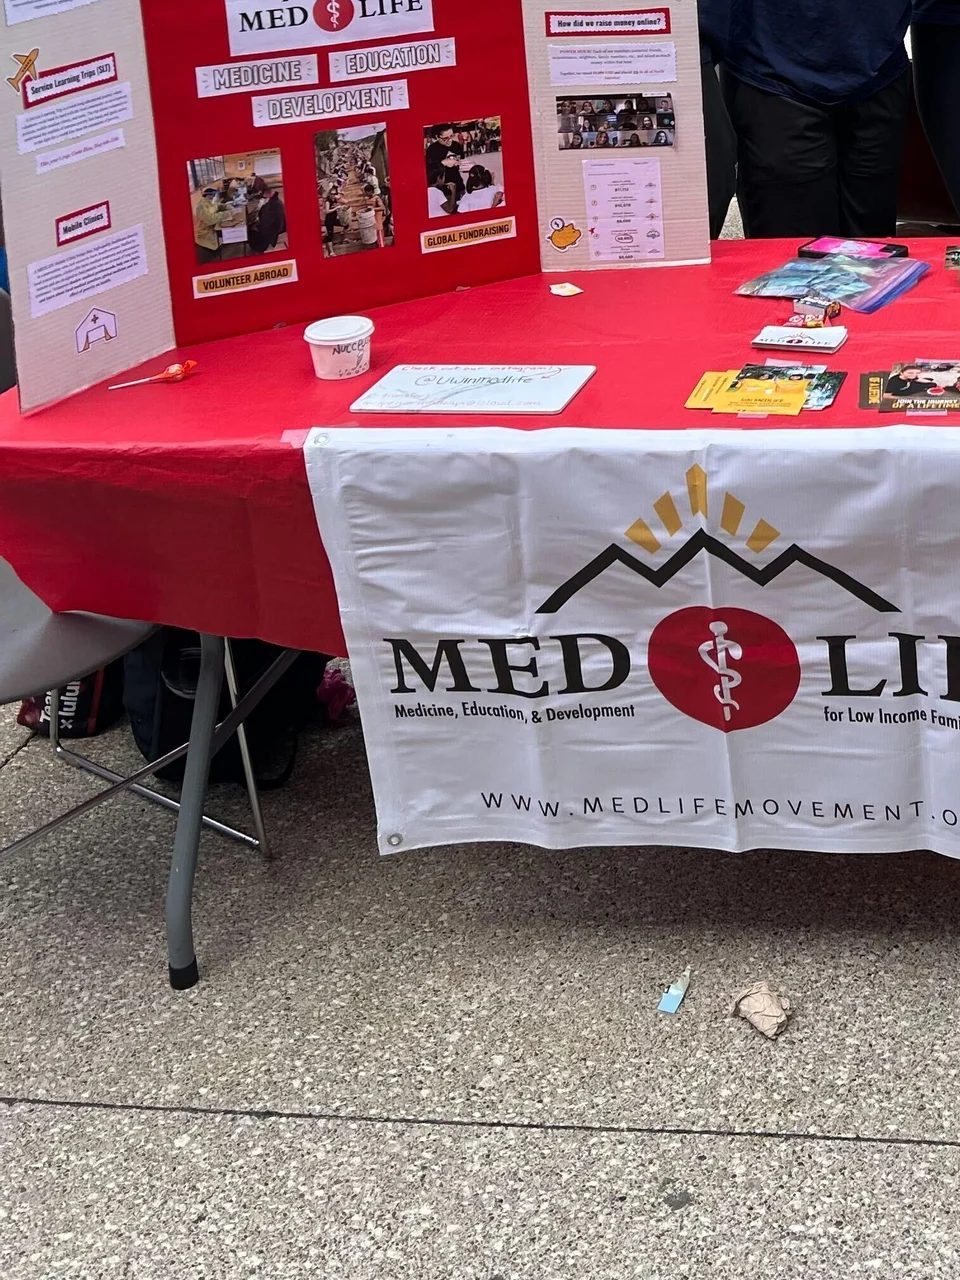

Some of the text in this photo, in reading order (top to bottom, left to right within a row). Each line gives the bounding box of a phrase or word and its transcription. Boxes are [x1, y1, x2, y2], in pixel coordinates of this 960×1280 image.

[238, 5, 309, 32] MED
[557, 17, 662, 30] How did we raise money online?
[213, 43, 441, 90] MEDICINE EDUCATION
[30, 80, 54, 95] Service
[54, 73, 81, 90] Learning
[81, 69, 97, 81] Trips
[268, 86, 394, 120] DEVELOPMENT
[62, 212, 104, 235] Mobile Clinics
[426, 223, 510, 247] GLOBAL FUNDRAISING
[202, 267, 289, 291] VOLUNTEER ABROAD
[382, 633, 632, 699] MED
[394, 701, 635, 724] Medicine, Education, & Development
[823, 705, 844, 722] for
[848, 707, 875, 723] Low
[879, 707, 928, 724] Income
